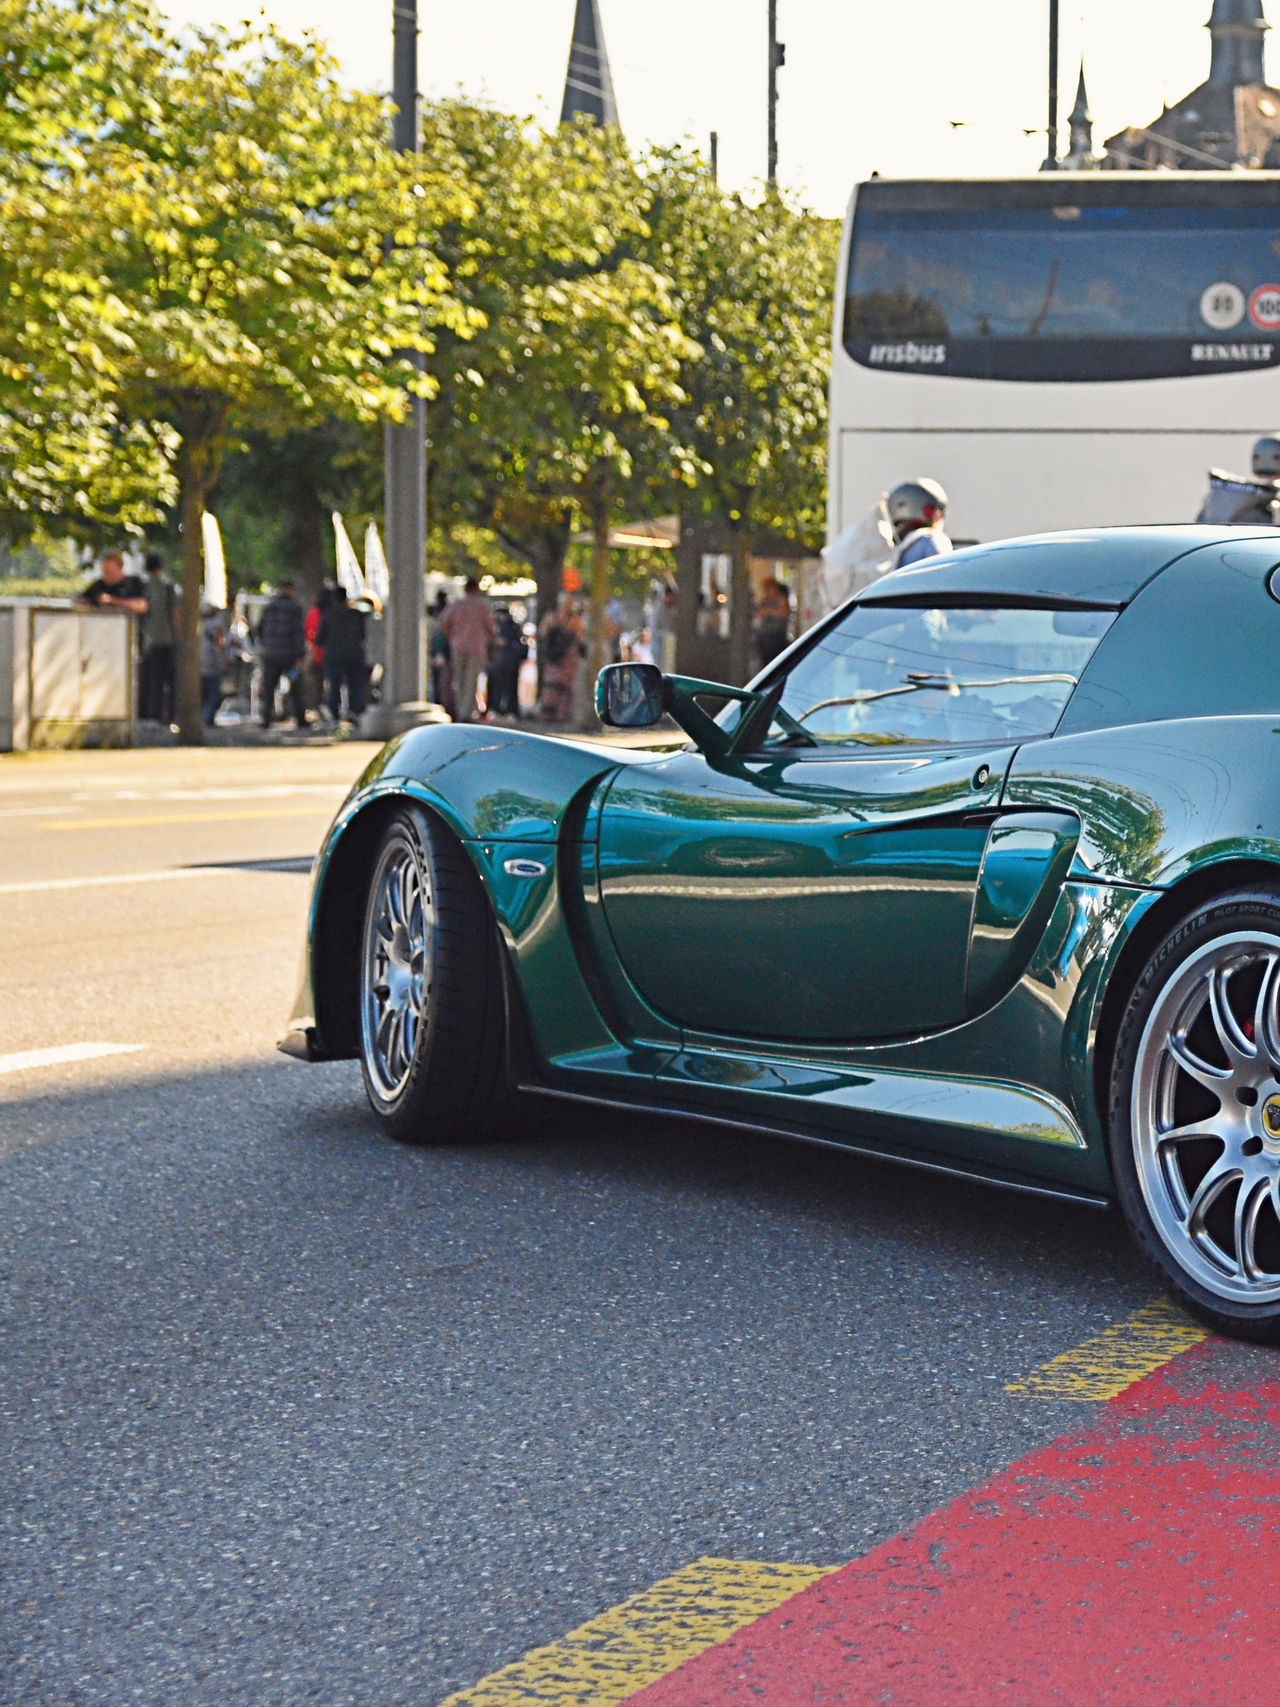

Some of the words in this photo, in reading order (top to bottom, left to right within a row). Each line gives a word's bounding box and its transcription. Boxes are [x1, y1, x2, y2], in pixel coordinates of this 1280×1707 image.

[1190, 343, 1273, 361] RENAULT
[1145, 913, 1208, 984] MICHELIN
[1214, 905, 1238, 918] PILOT
[1238, 904, 1266, 914] SPORT
